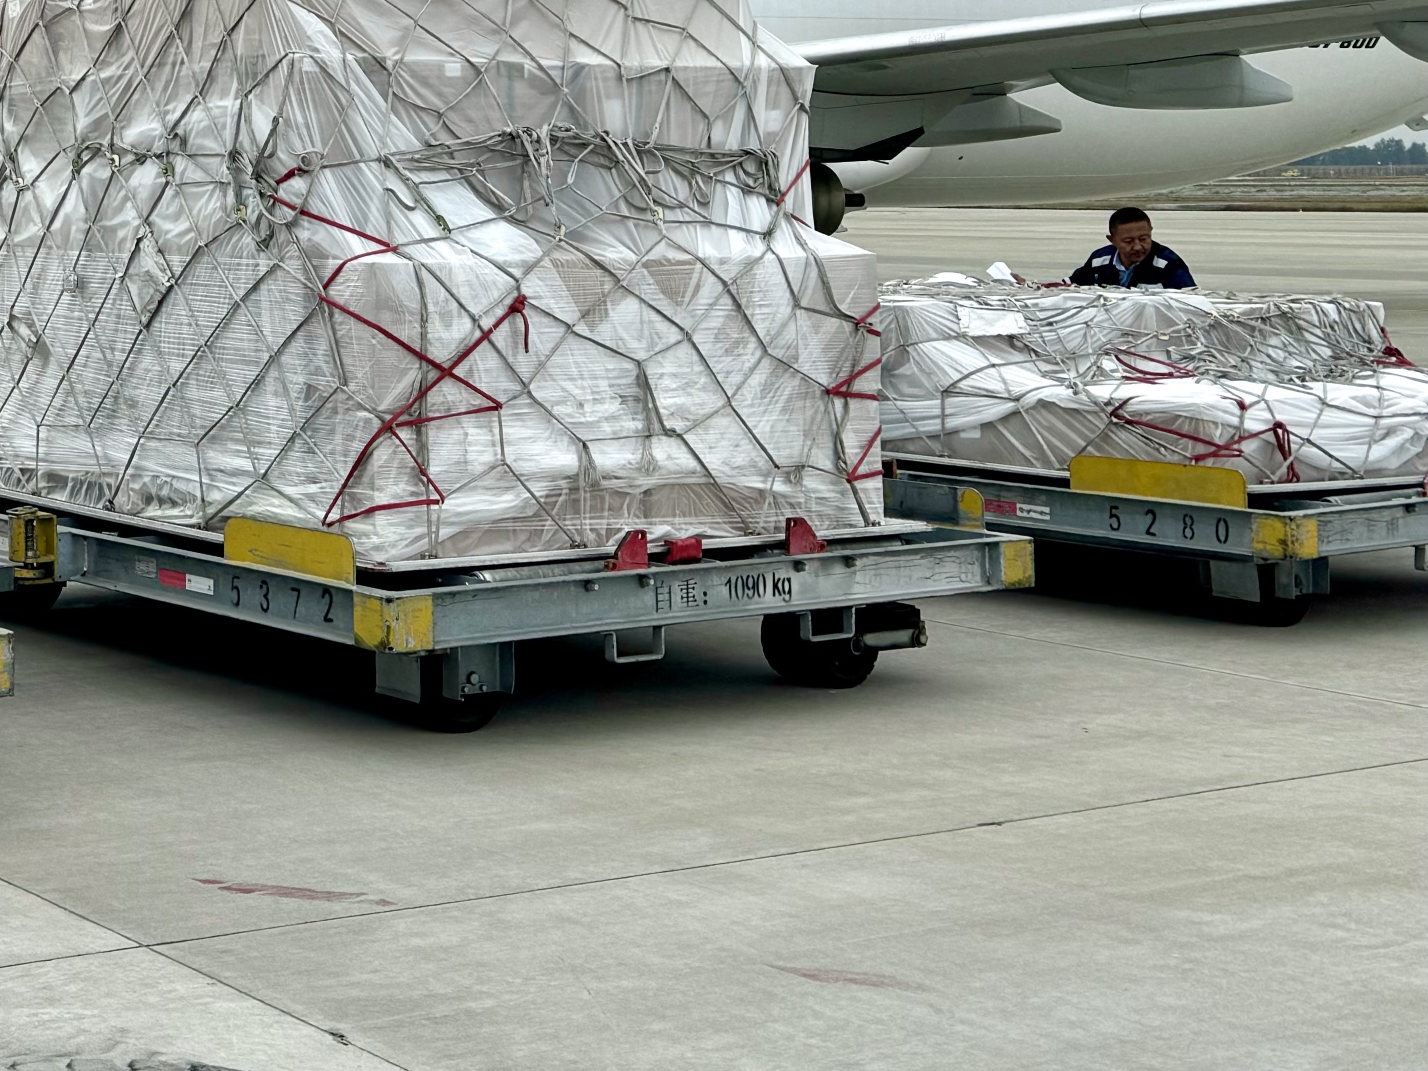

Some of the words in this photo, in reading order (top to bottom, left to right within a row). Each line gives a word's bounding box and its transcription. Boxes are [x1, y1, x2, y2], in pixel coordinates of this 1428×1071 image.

[1108, 504, 1230, 545] 5280
[230, 575, 335, 623] 5372
[724, 572, 767, 602] 1090
[772, 571, 793, 603] kg
